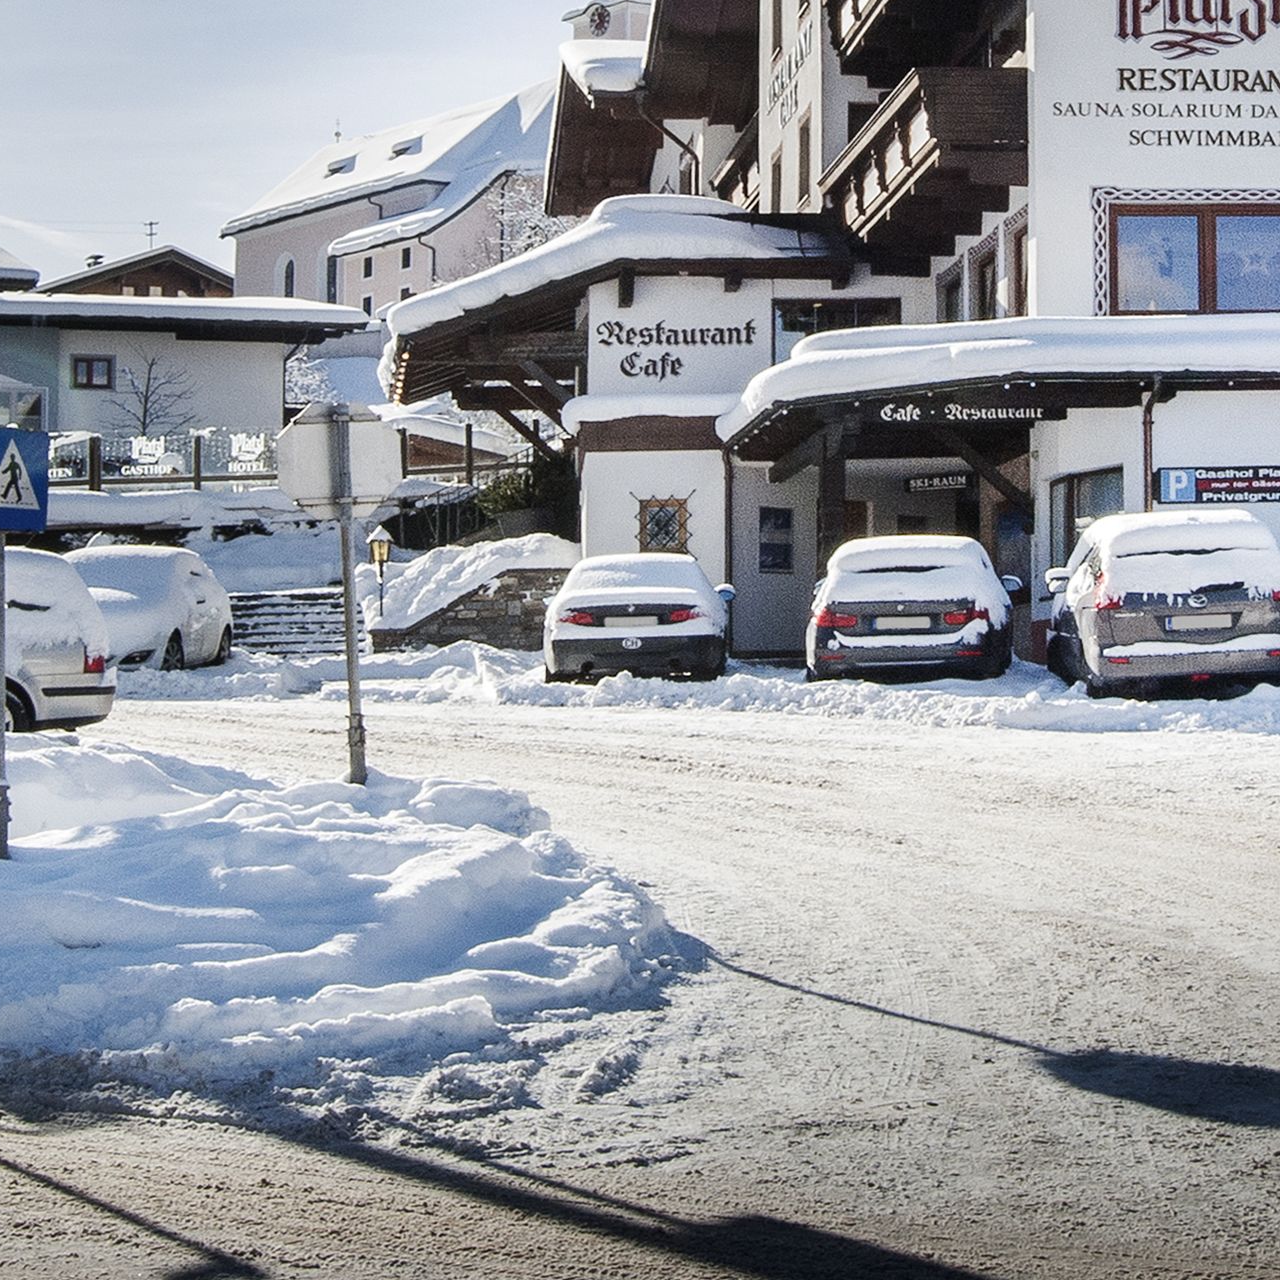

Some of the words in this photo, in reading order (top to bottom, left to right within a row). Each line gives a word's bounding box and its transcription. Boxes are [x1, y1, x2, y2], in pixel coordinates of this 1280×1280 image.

[1131, 103, 1243, 119] SOLARIUM
[595, 318, 757, 348] Restaurant
[619, 351, 684, 382] Cafe
[880, 403, 921, 422] Cafe
[944, 403, 1044, 420] Restaurant
[228, 460, 267, 472] HOTEL
[1195, 468, 1253, 480] Gasthof
[909, 475, 967, 488] SKI-RAUM
